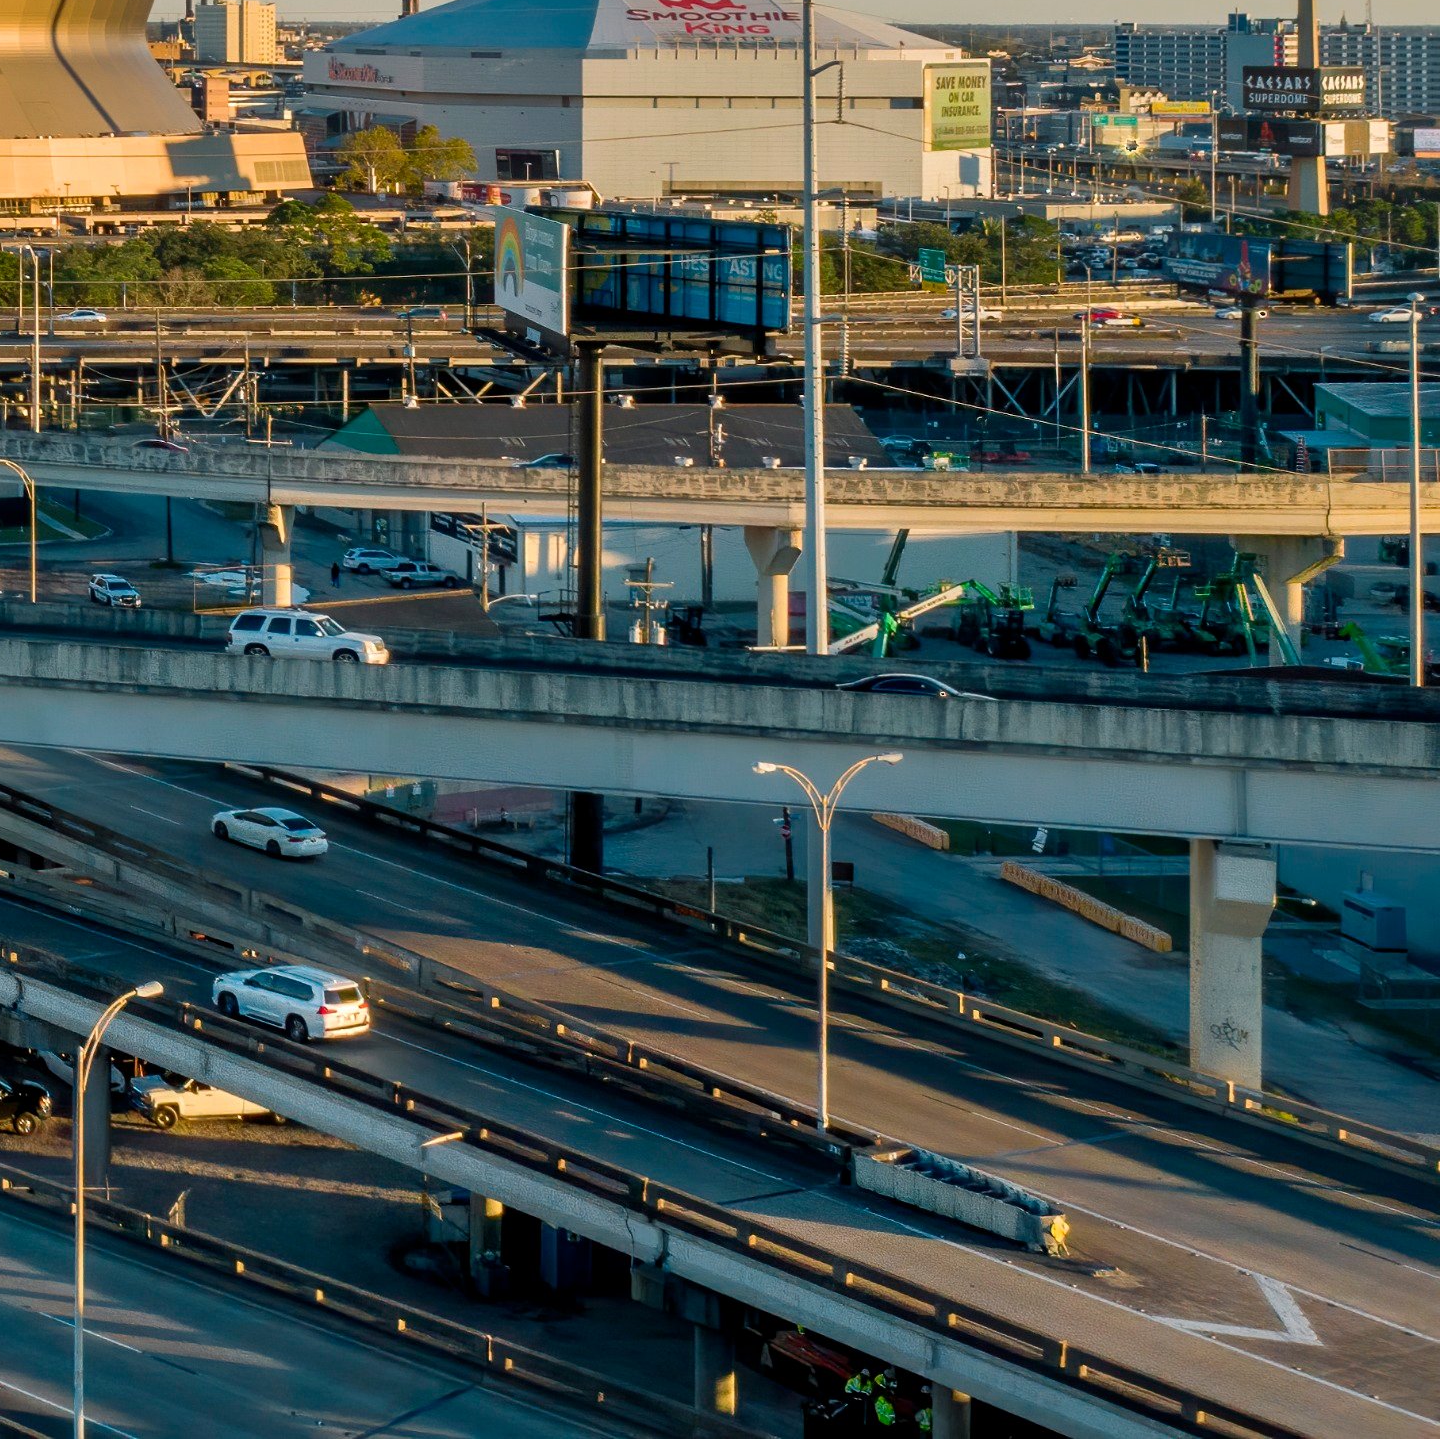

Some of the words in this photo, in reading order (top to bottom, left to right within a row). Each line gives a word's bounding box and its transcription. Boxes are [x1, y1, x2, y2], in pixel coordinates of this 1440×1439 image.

[626, 9, 802, 21] SMOOTHIE
[936, 76, 956, 90] SAVE
[958, 75, 987, 89] MONEY
[1246, 75, 1311, 90] CAESARS
[1321, 74, 1364, 90] CAESARS
[948, 92, 959, 103] ON
[961, 91, 975, 102] CAR
[1248, 93, 1308, 104] SUPERDOME
[1323, 93, 1362, 104] SUPERDOME
